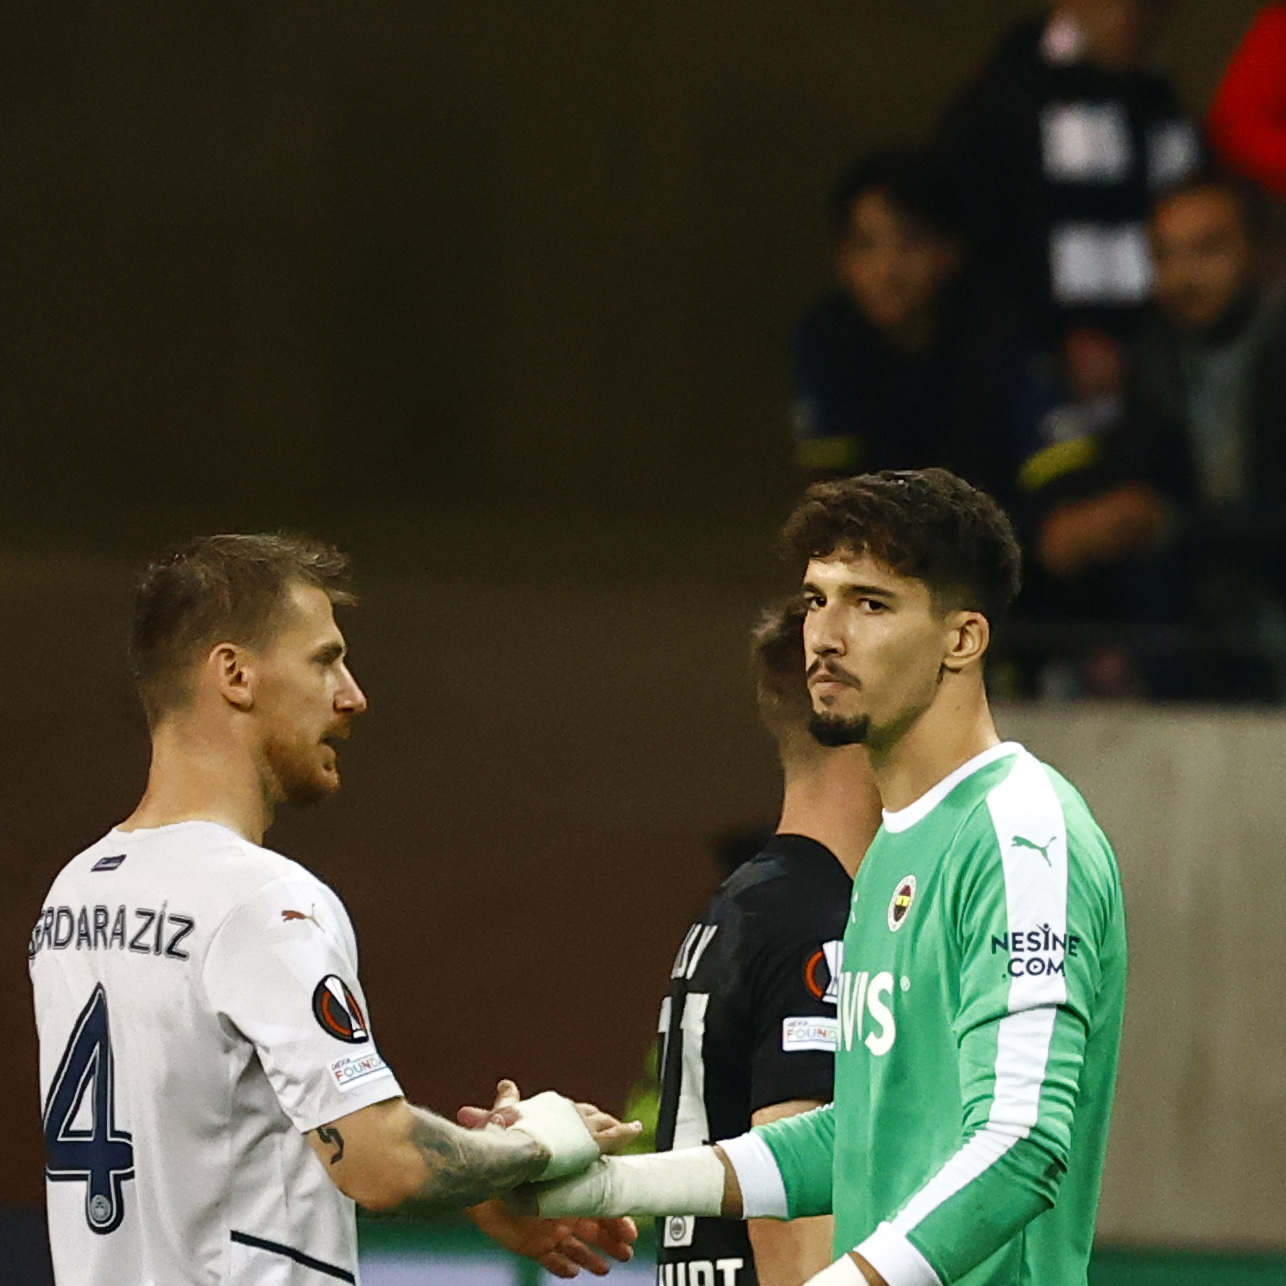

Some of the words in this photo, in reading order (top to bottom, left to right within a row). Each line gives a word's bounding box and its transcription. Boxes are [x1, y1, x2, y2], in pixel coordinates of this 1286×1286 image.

[1002, 957, 1067, 981] .COM
[836, 971, 897, 1056] VIS
[44, 981, 135, 1234] 4
